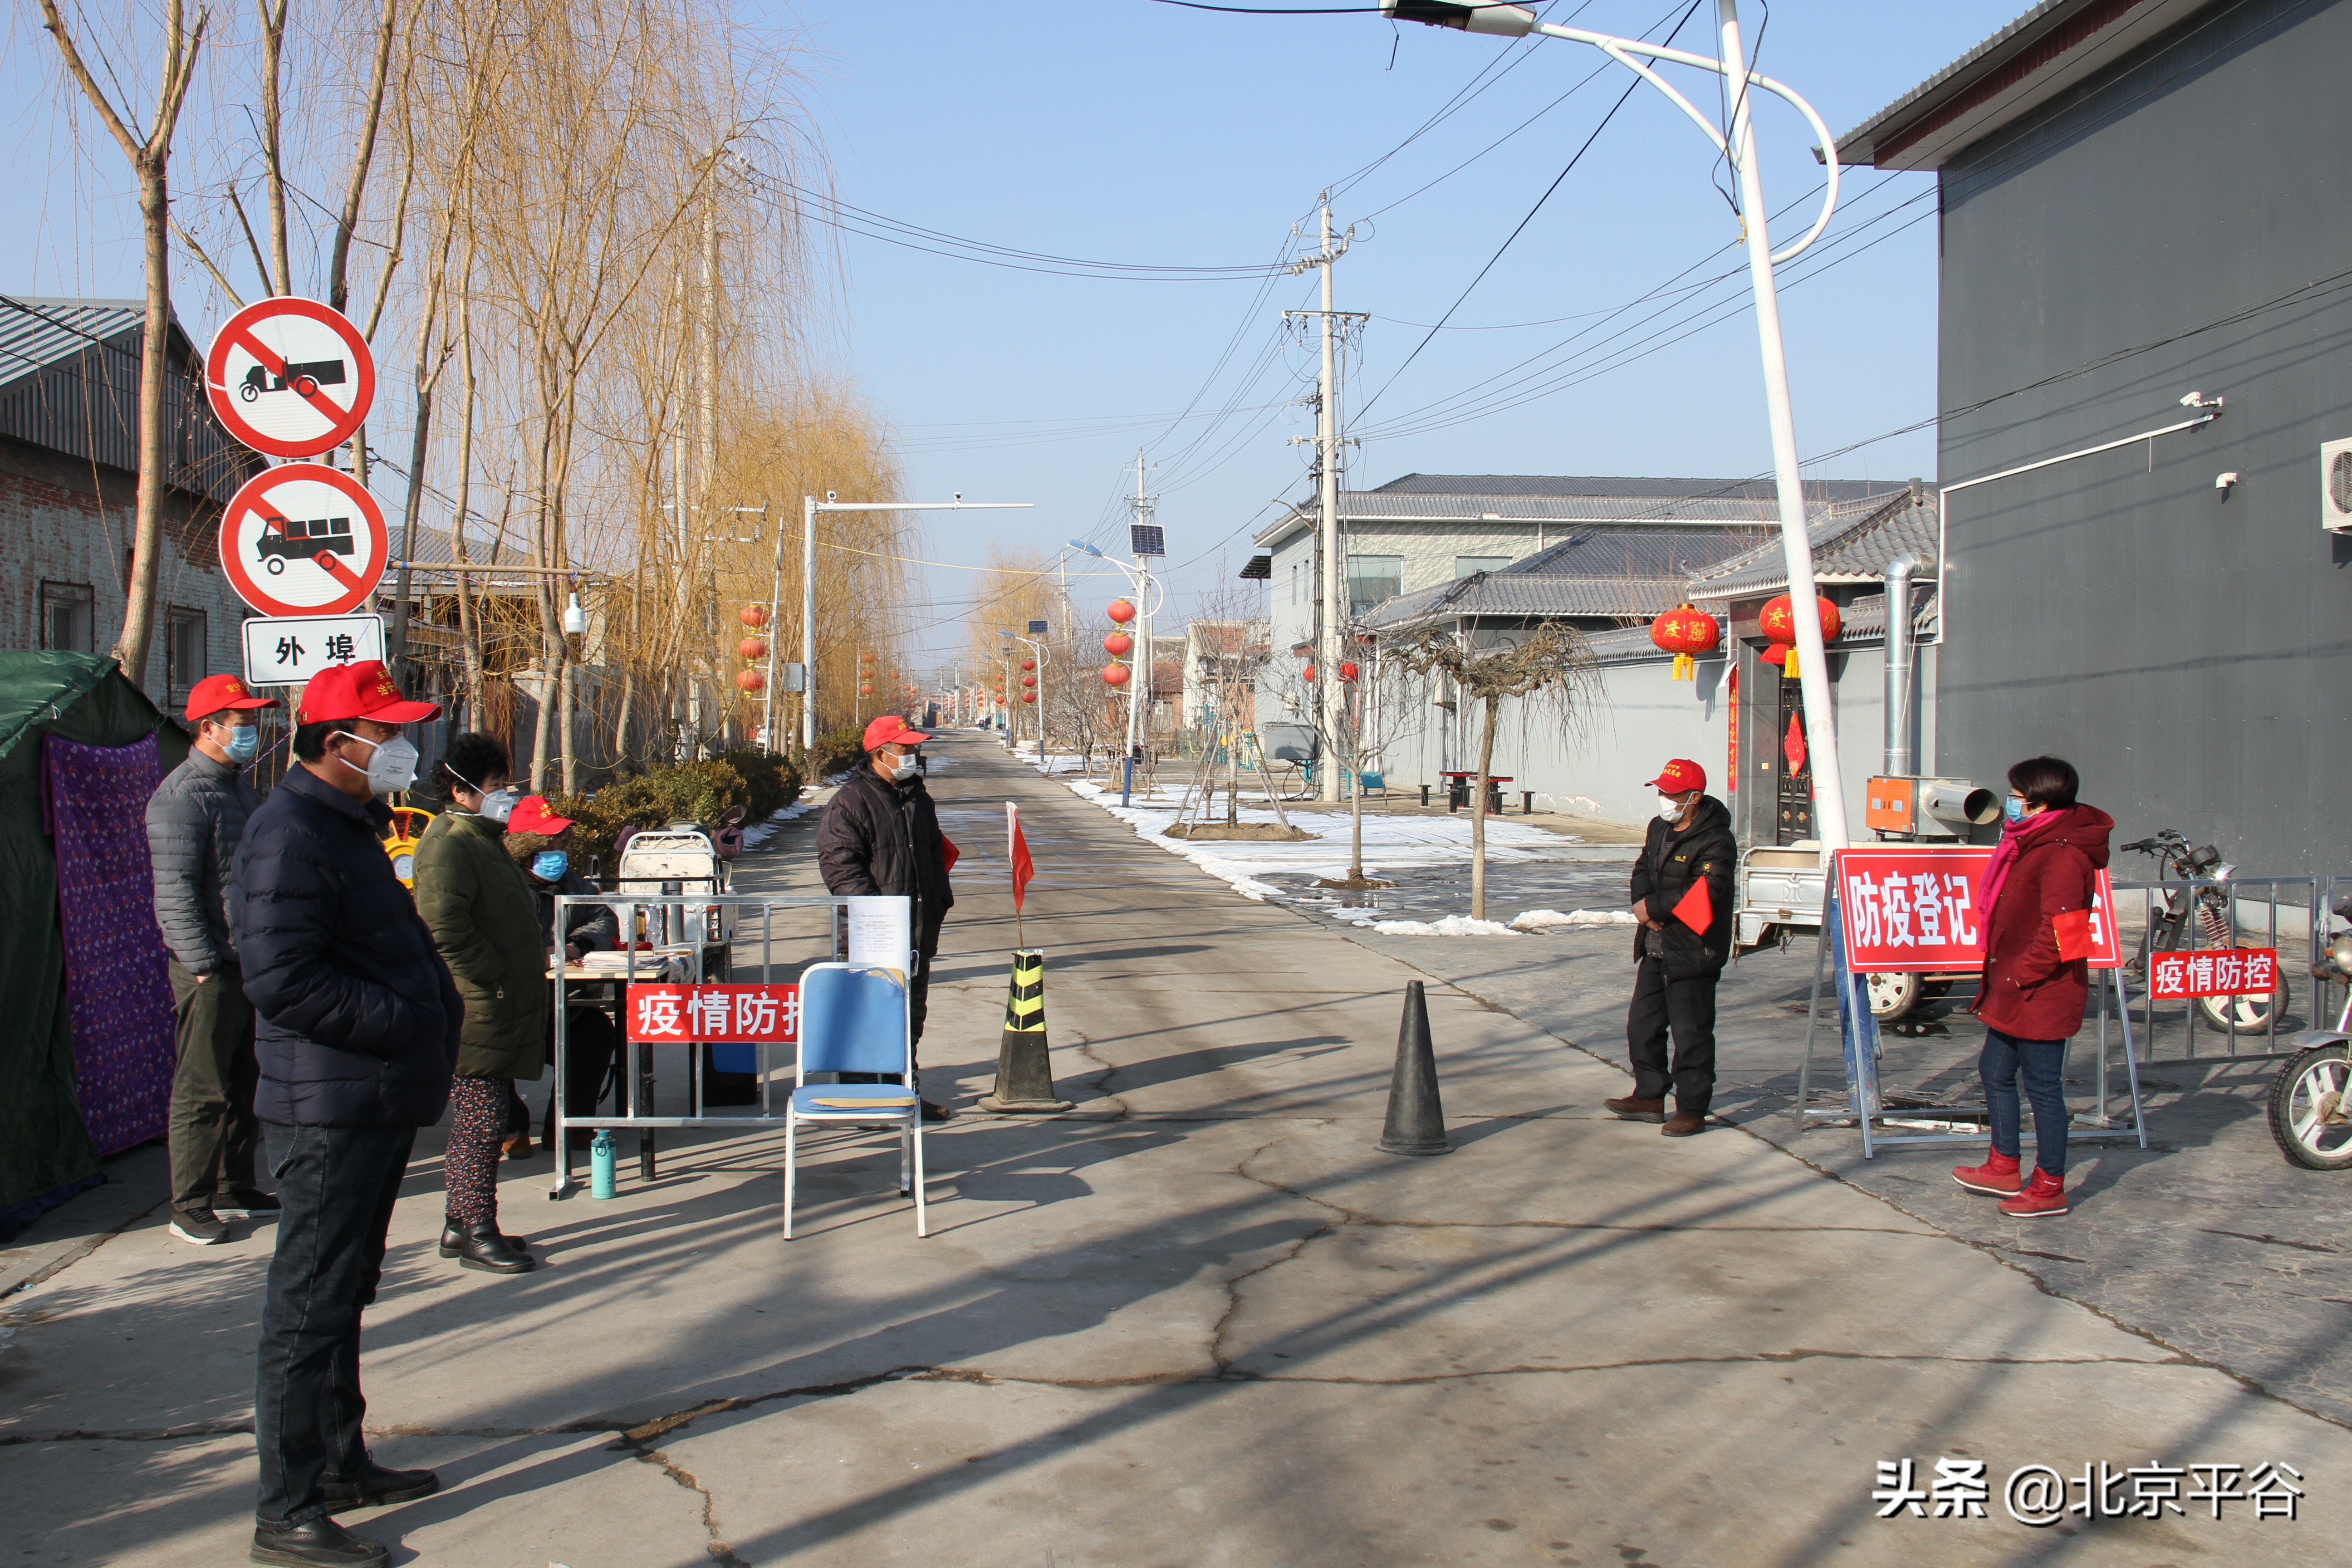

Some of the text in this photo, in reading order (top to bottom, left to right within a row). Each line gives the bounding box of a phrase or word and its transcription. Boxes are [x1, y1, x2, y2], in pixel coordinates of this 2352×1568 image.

[275, 634, 356, 666] 外埠
[1849, 871, 1977, 948] 防疫登记
[2156, 954, 2271, 994] 疫情防控
